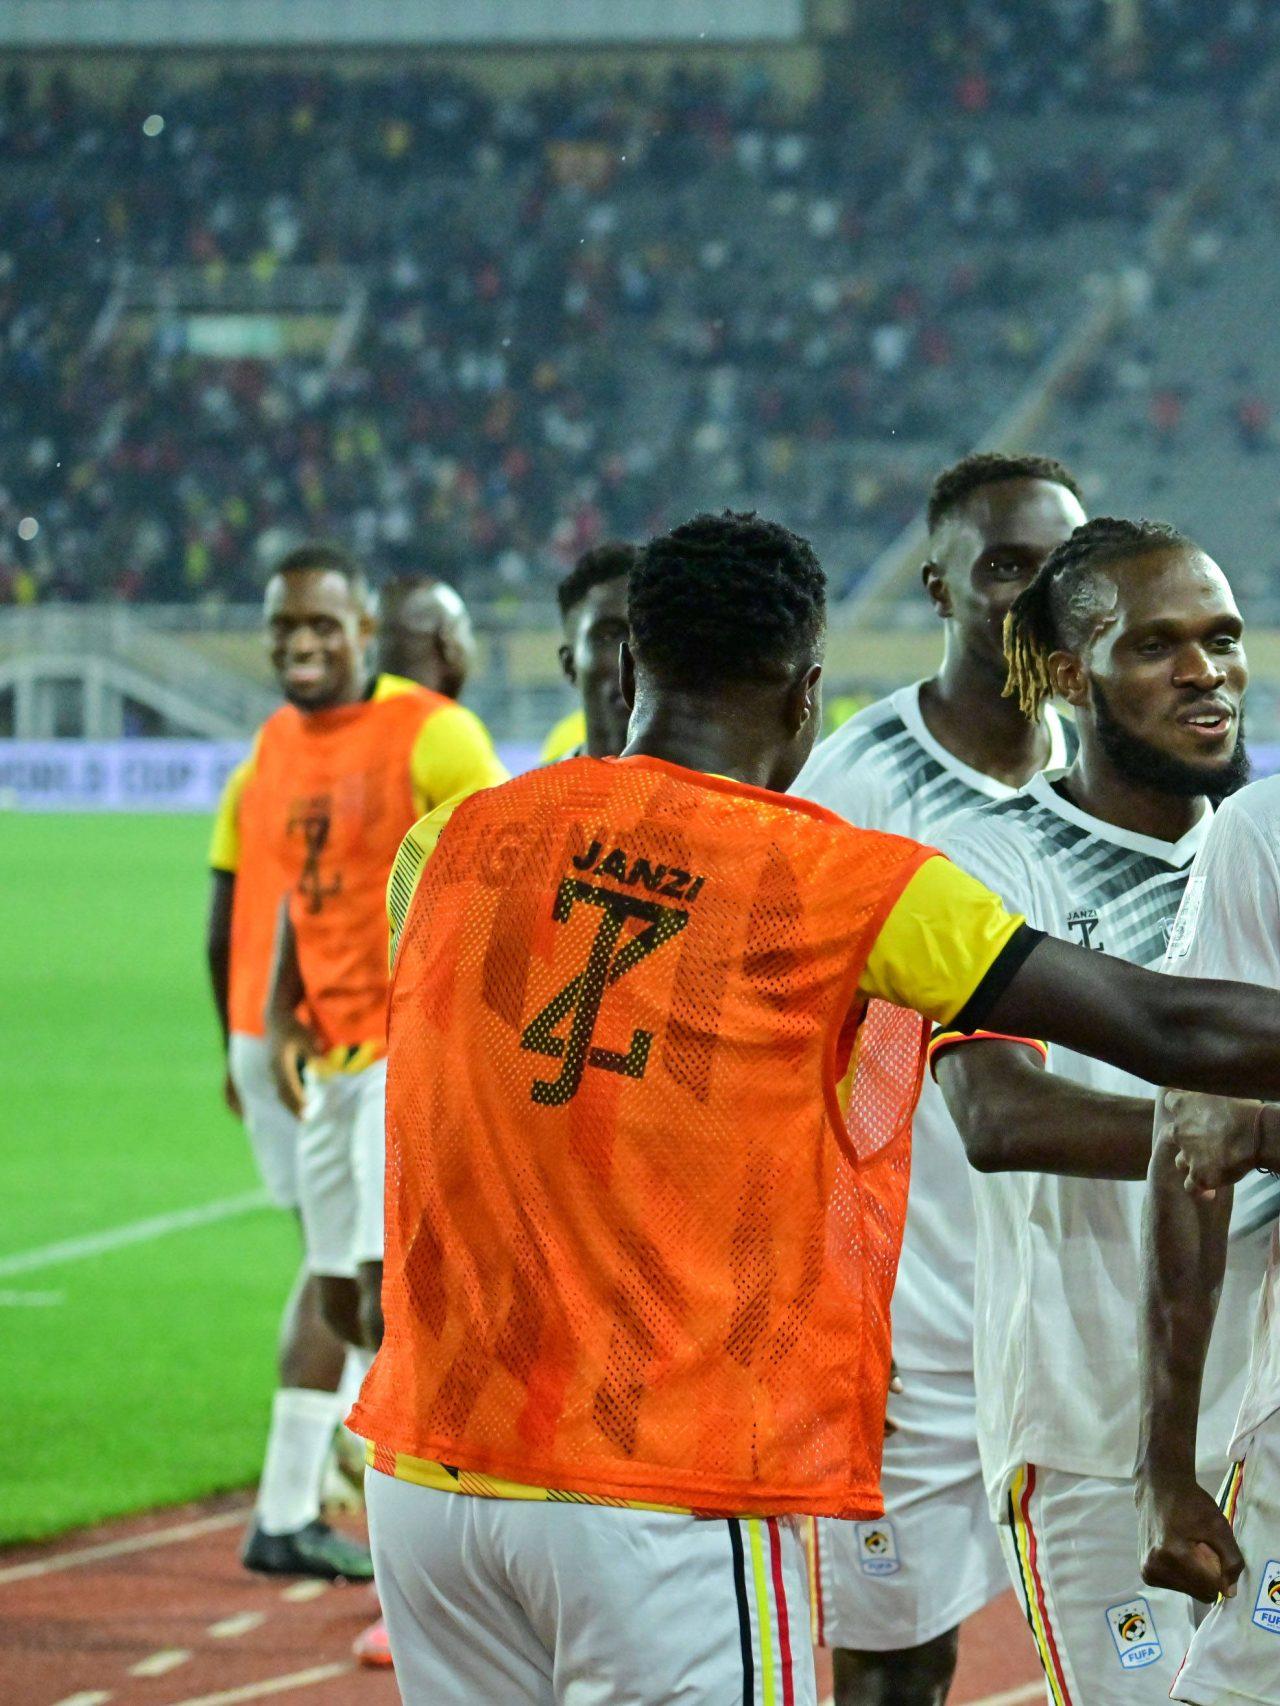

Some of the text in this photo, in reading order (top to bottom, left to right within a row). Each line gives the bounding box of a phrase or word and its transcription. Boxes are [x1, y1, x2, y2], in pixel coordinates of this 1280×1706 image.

[572, 839, 706, 902] JANZI
[1067, 908, 1098, 920] JANZI
[1128, 1647, 1155, 1662] FUFA
